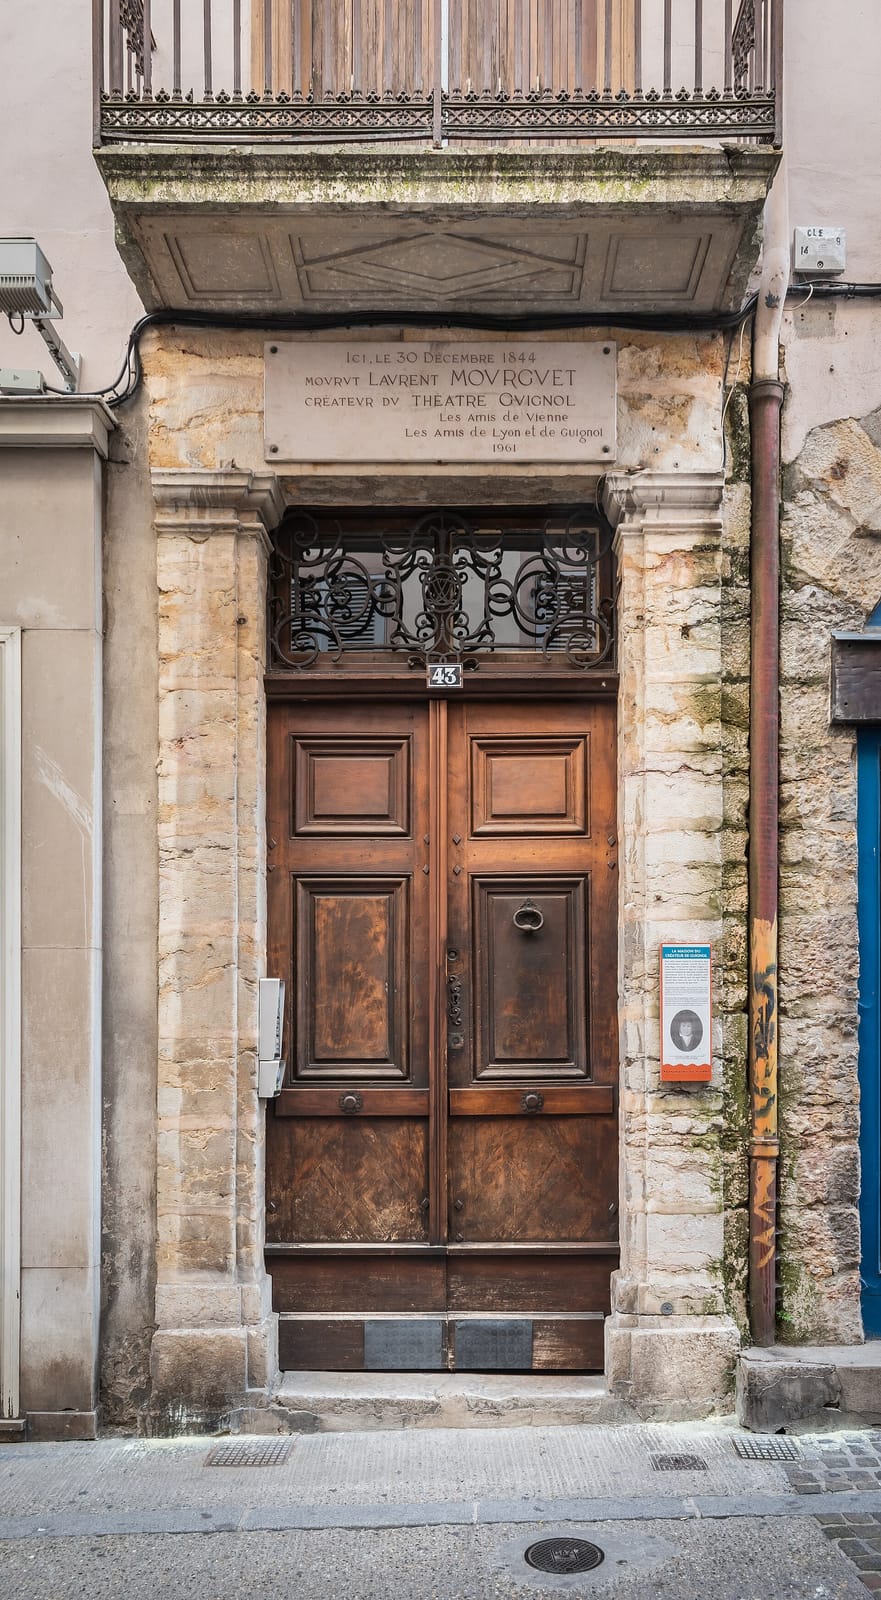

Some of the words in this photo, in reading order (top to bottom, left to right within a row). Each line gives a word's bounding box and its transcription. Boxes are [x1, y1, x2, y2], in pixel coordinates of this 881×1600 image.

[396, 351, 418, 364] 30
[502, 351, 536, 363] 1844
[439, 412, 461, 422] Les
[502, 410, 520, 422] de
[526, 412, 569, 422] Vienne
[405, 428, 428, 438] Les
[470, 426, 487, 437] de
[492, 428, 520, 441] Lyon
[524, 426, 536, 437] et
[539, 426, 556, 437] de
[560, 427, 603, 443] Guignol
[492, 443, 516, 453] 1961
[431, 667, 457, 685] 43
